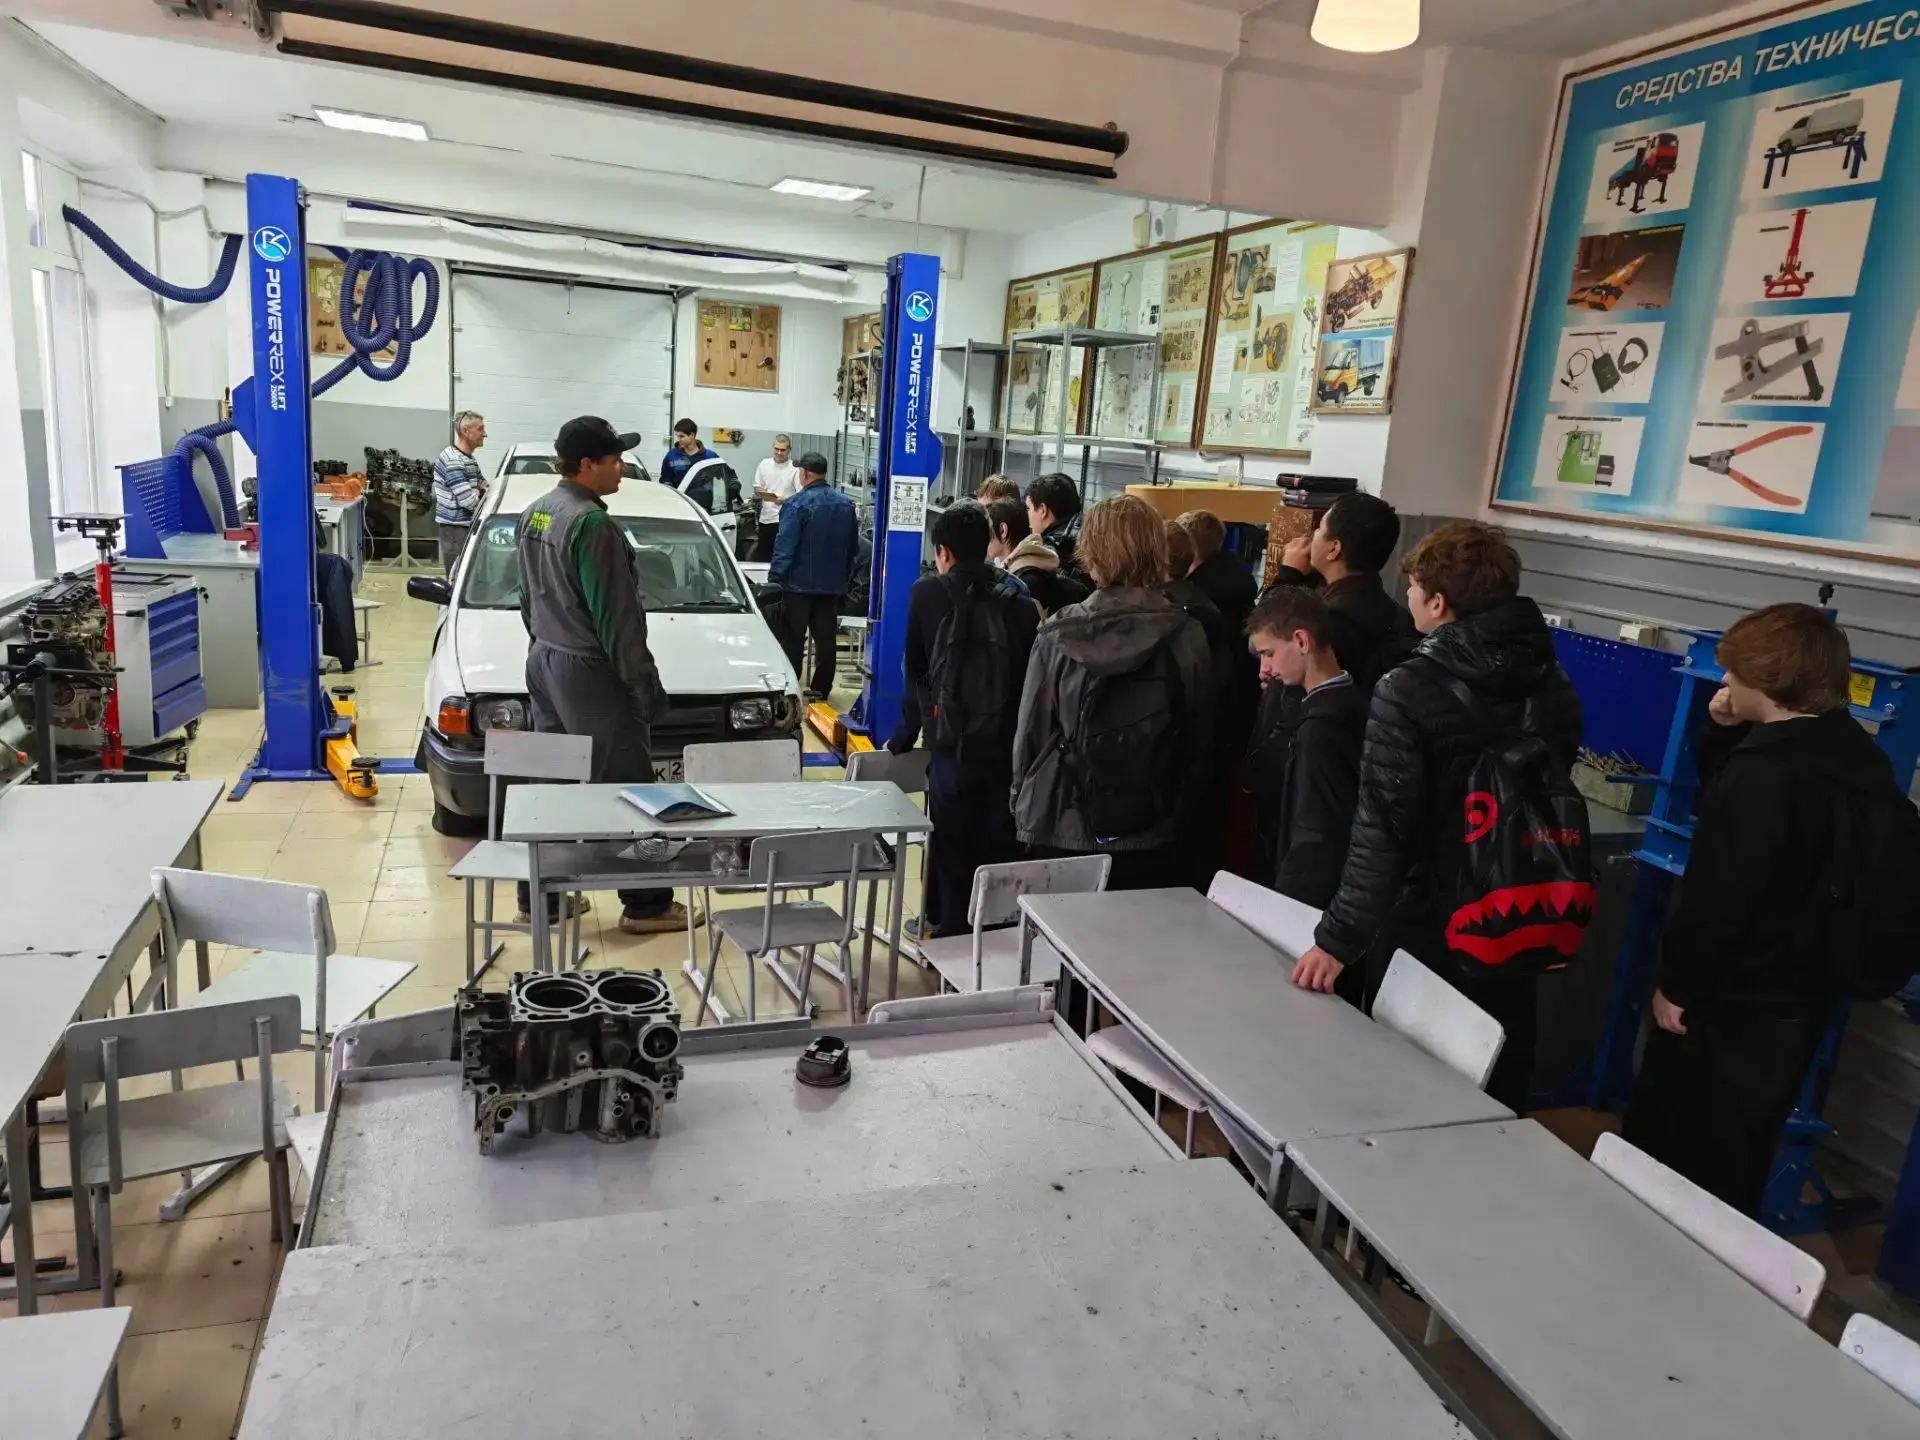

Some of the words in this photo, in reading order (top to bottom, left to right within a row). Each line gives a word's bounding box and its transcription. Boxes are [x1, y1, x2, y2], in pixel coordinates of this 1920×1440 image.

[1615, 54, 1743, 110] СРЕДСТВА
[1753, 9, 1920, 76] ТЕХНИЧЕС
[265, 268, 285, 383] POWERREX
[277, 385, 286, 410] LIFT
[906, 332, 924, 430] POWERREX
[655, 767, 666, 781] K
[672, 761, 684, 776] 2
